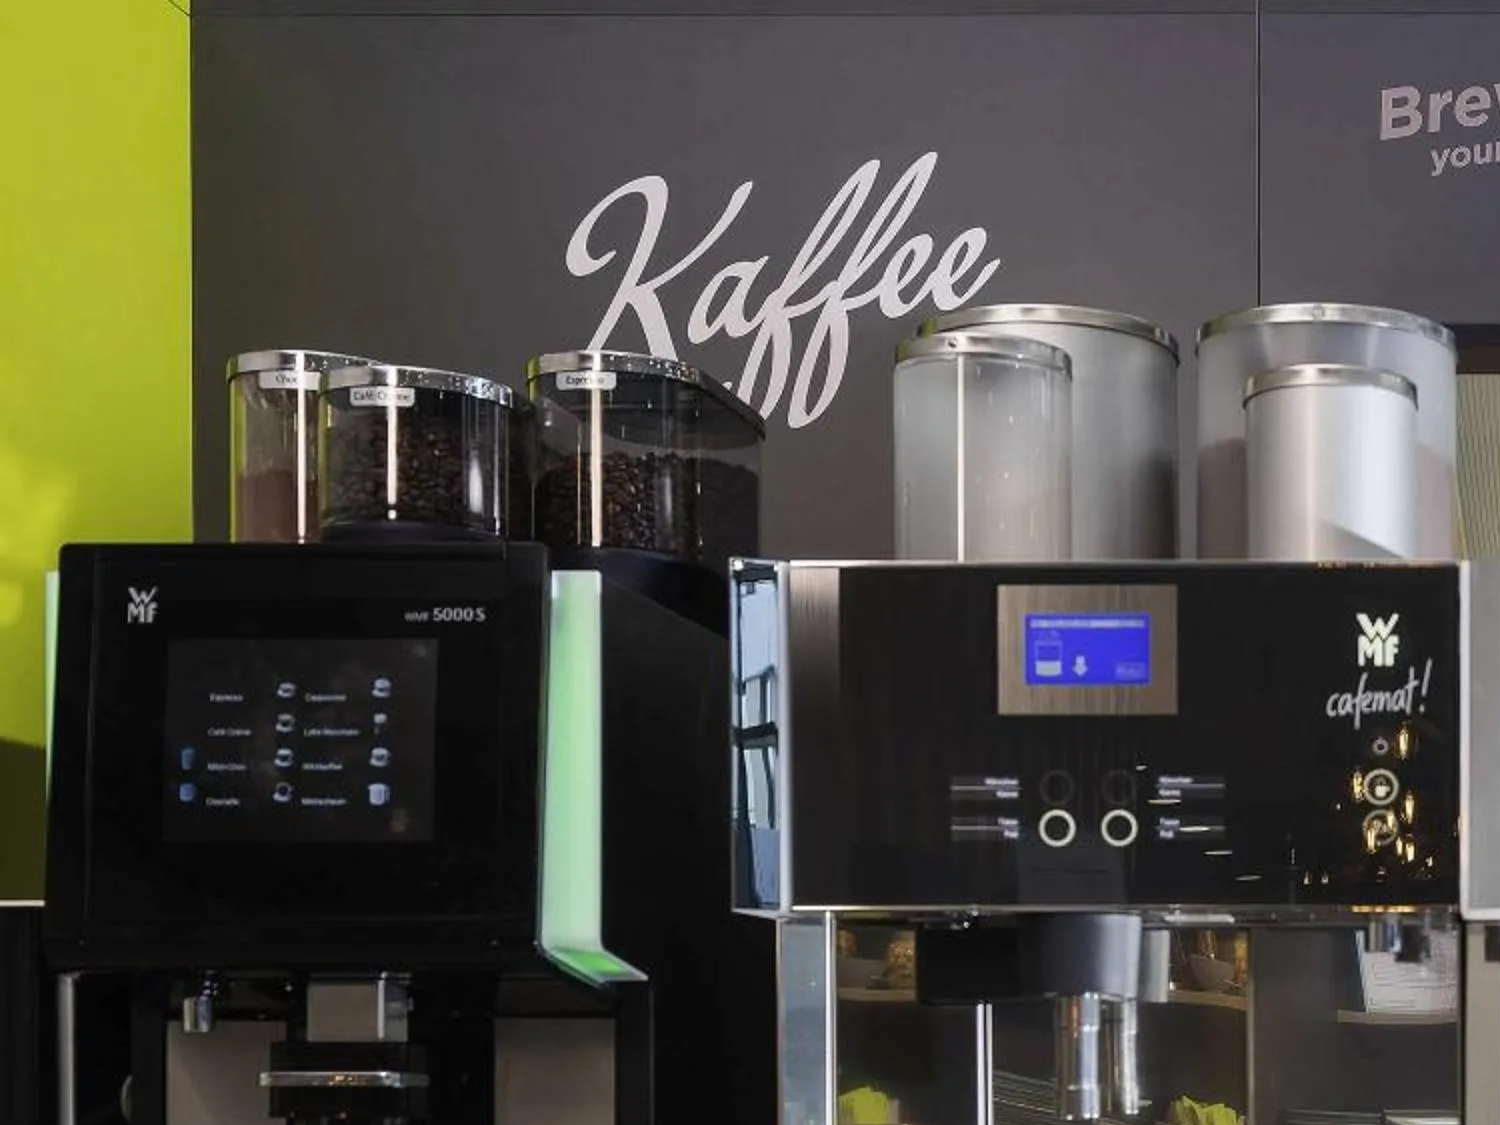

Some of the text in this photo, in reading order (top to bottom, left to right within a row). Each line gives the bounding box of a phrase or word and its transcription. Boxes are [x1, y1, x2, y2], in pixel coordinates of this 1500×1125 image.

[565, 151, 1001, 429] Kaffee
[127, 586, 159, 624] WMF
[1355, 612, 1400, 667] WMF
[1325, 658, 1433, 731] cafemat!
